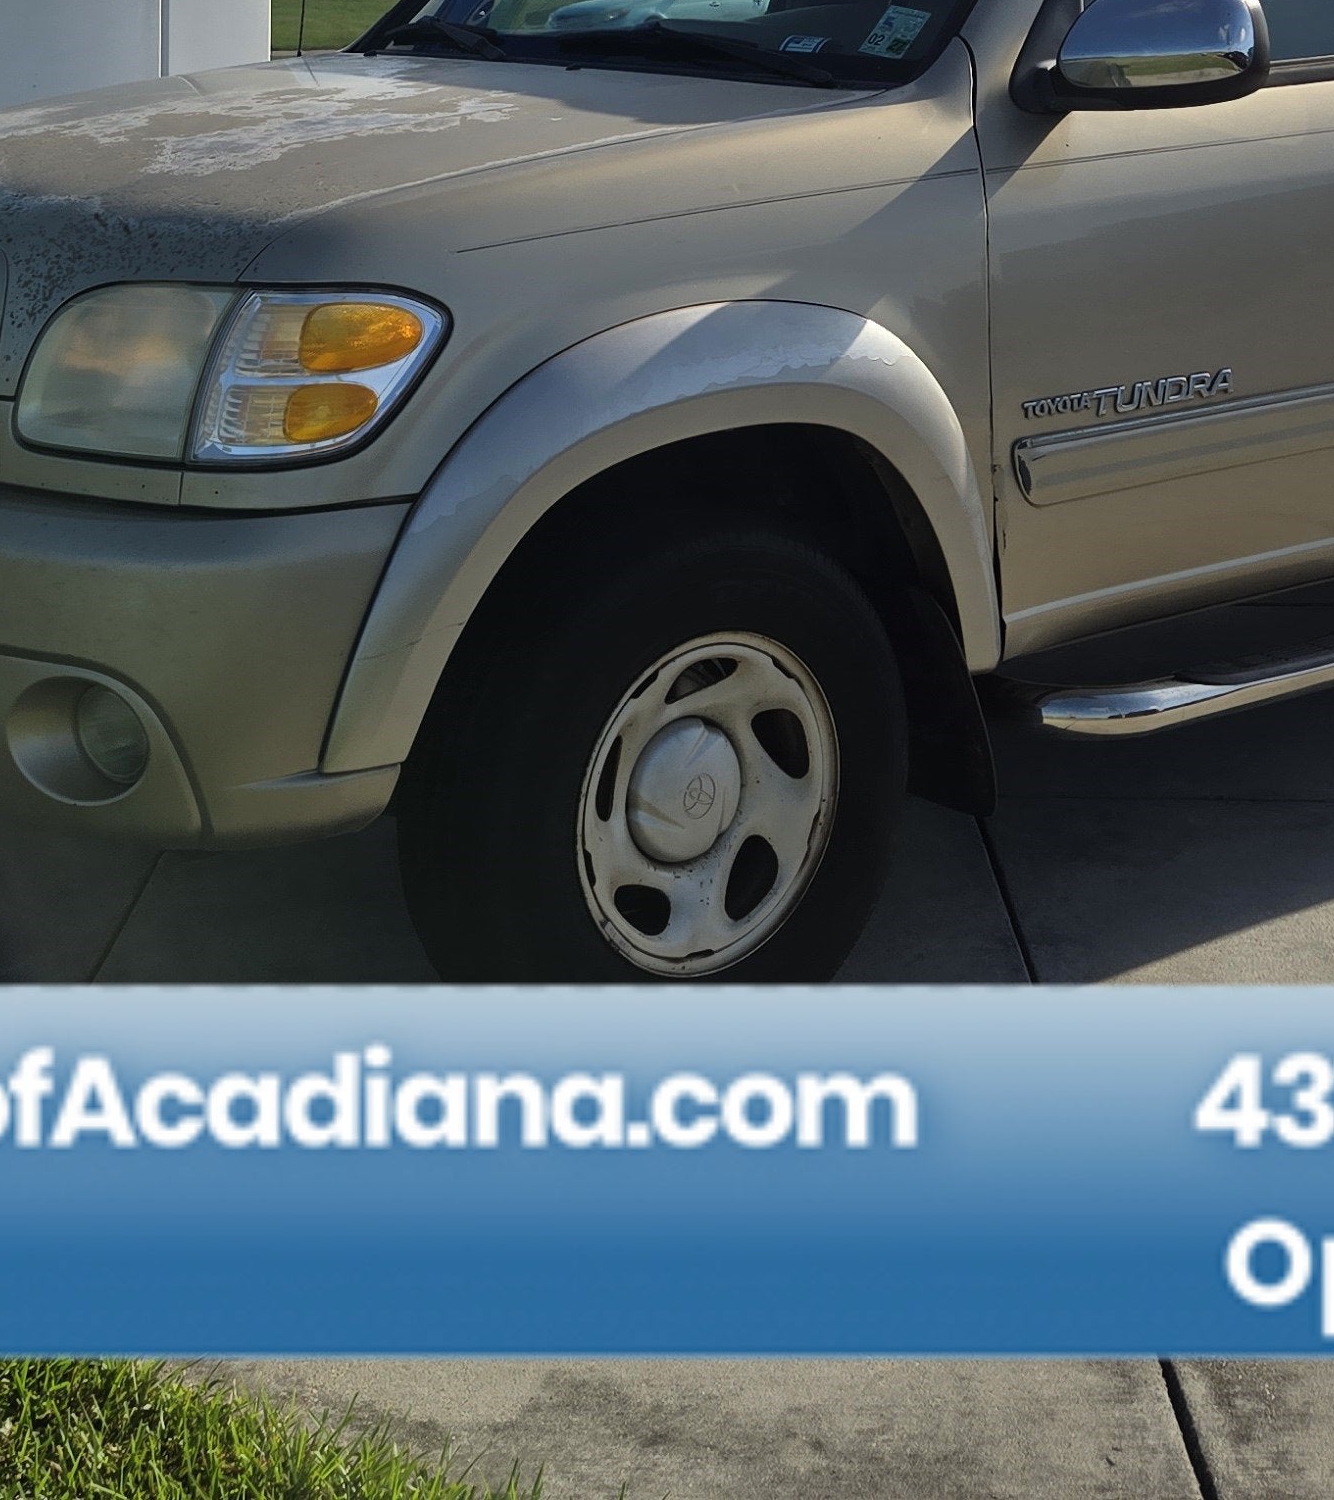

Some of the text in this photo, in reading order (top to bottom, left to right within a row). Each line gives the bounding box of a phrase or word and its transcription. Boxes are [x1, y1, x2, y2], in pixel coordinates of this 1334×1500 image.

[868, 33, 885, 46] 02
[1023, 367, 1234, 419] TOYOTA TUNDRA
